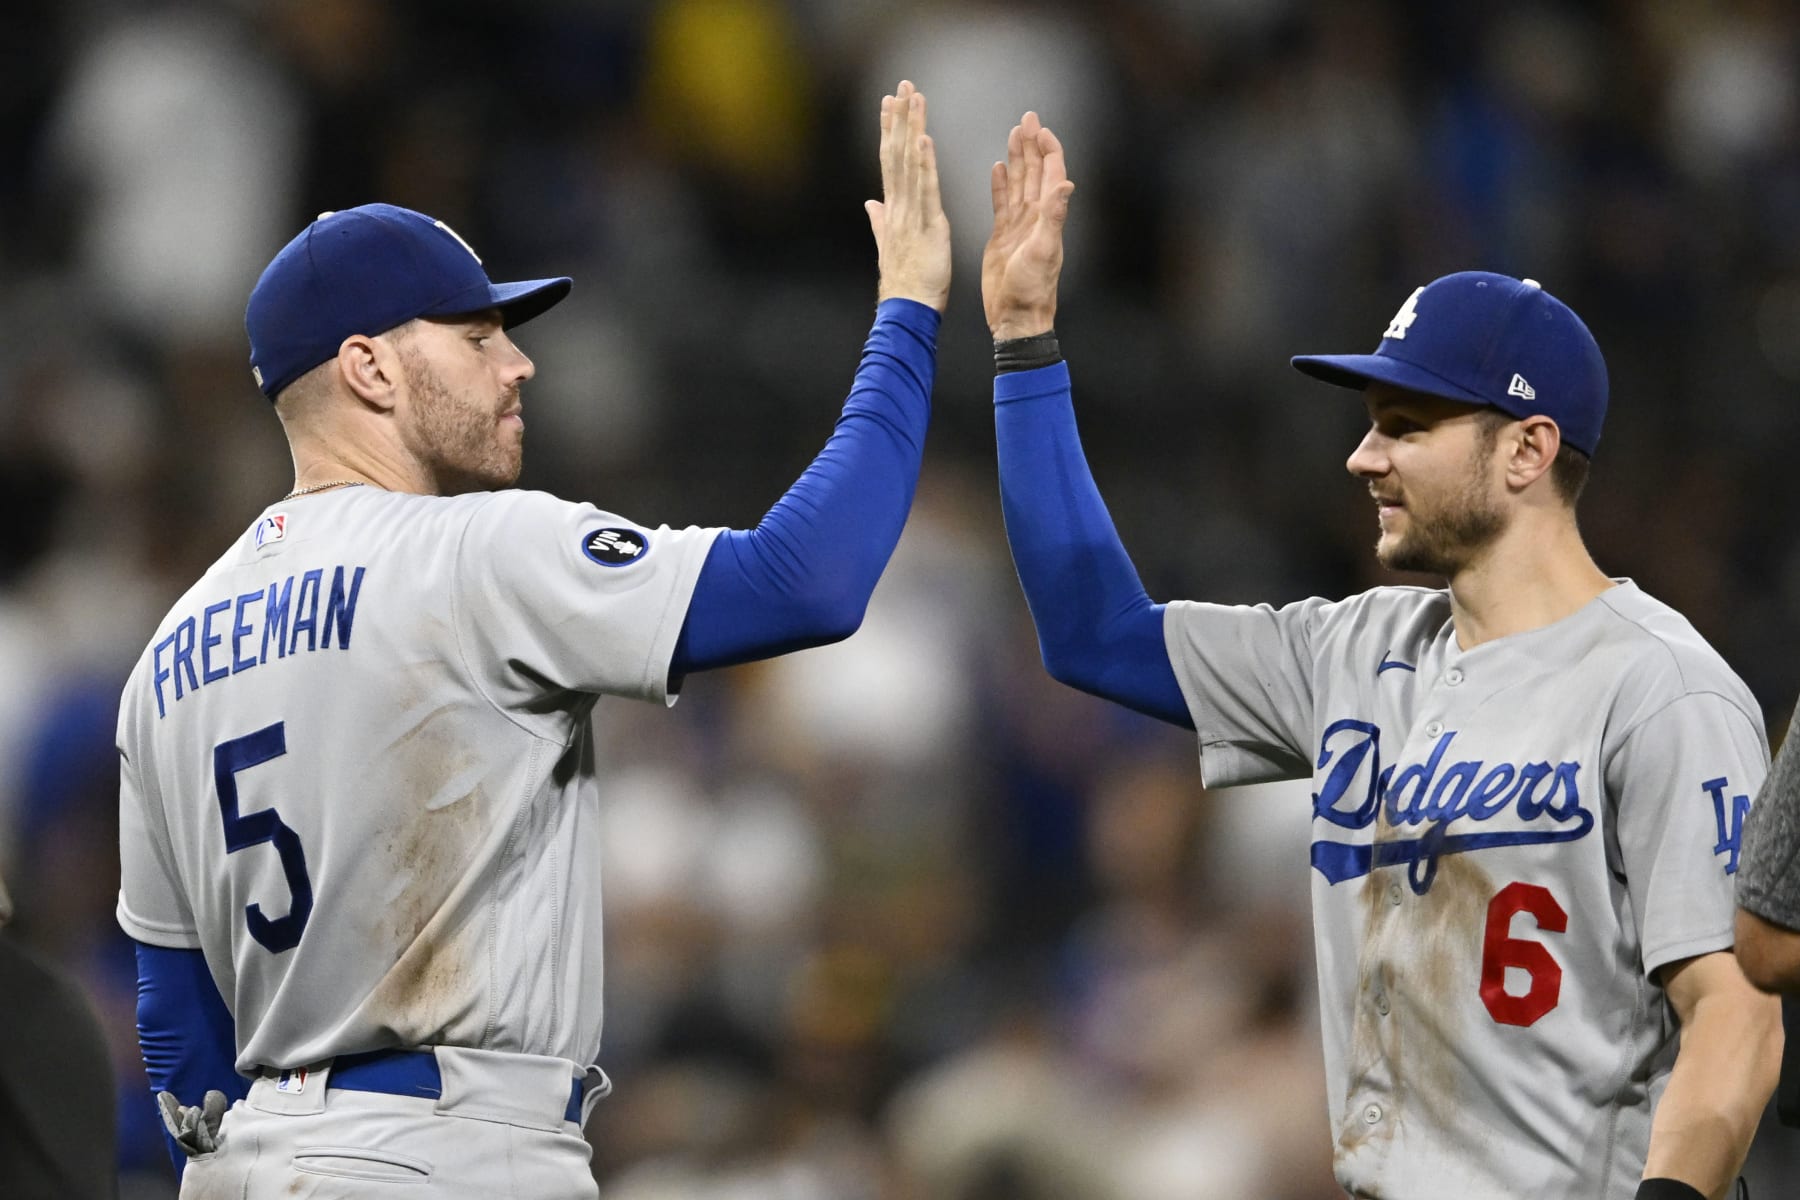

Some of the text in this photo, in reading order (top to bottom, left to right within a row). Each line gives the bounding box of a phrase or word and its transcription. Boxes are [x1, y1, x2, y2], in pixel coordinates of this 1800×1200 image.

[588, 530, 621, 551] VIN
[153, 565, 366, 719] FREEMAN
[214, 720, 313, 954] 5
[1478, 881, 1568, 1028] 6
